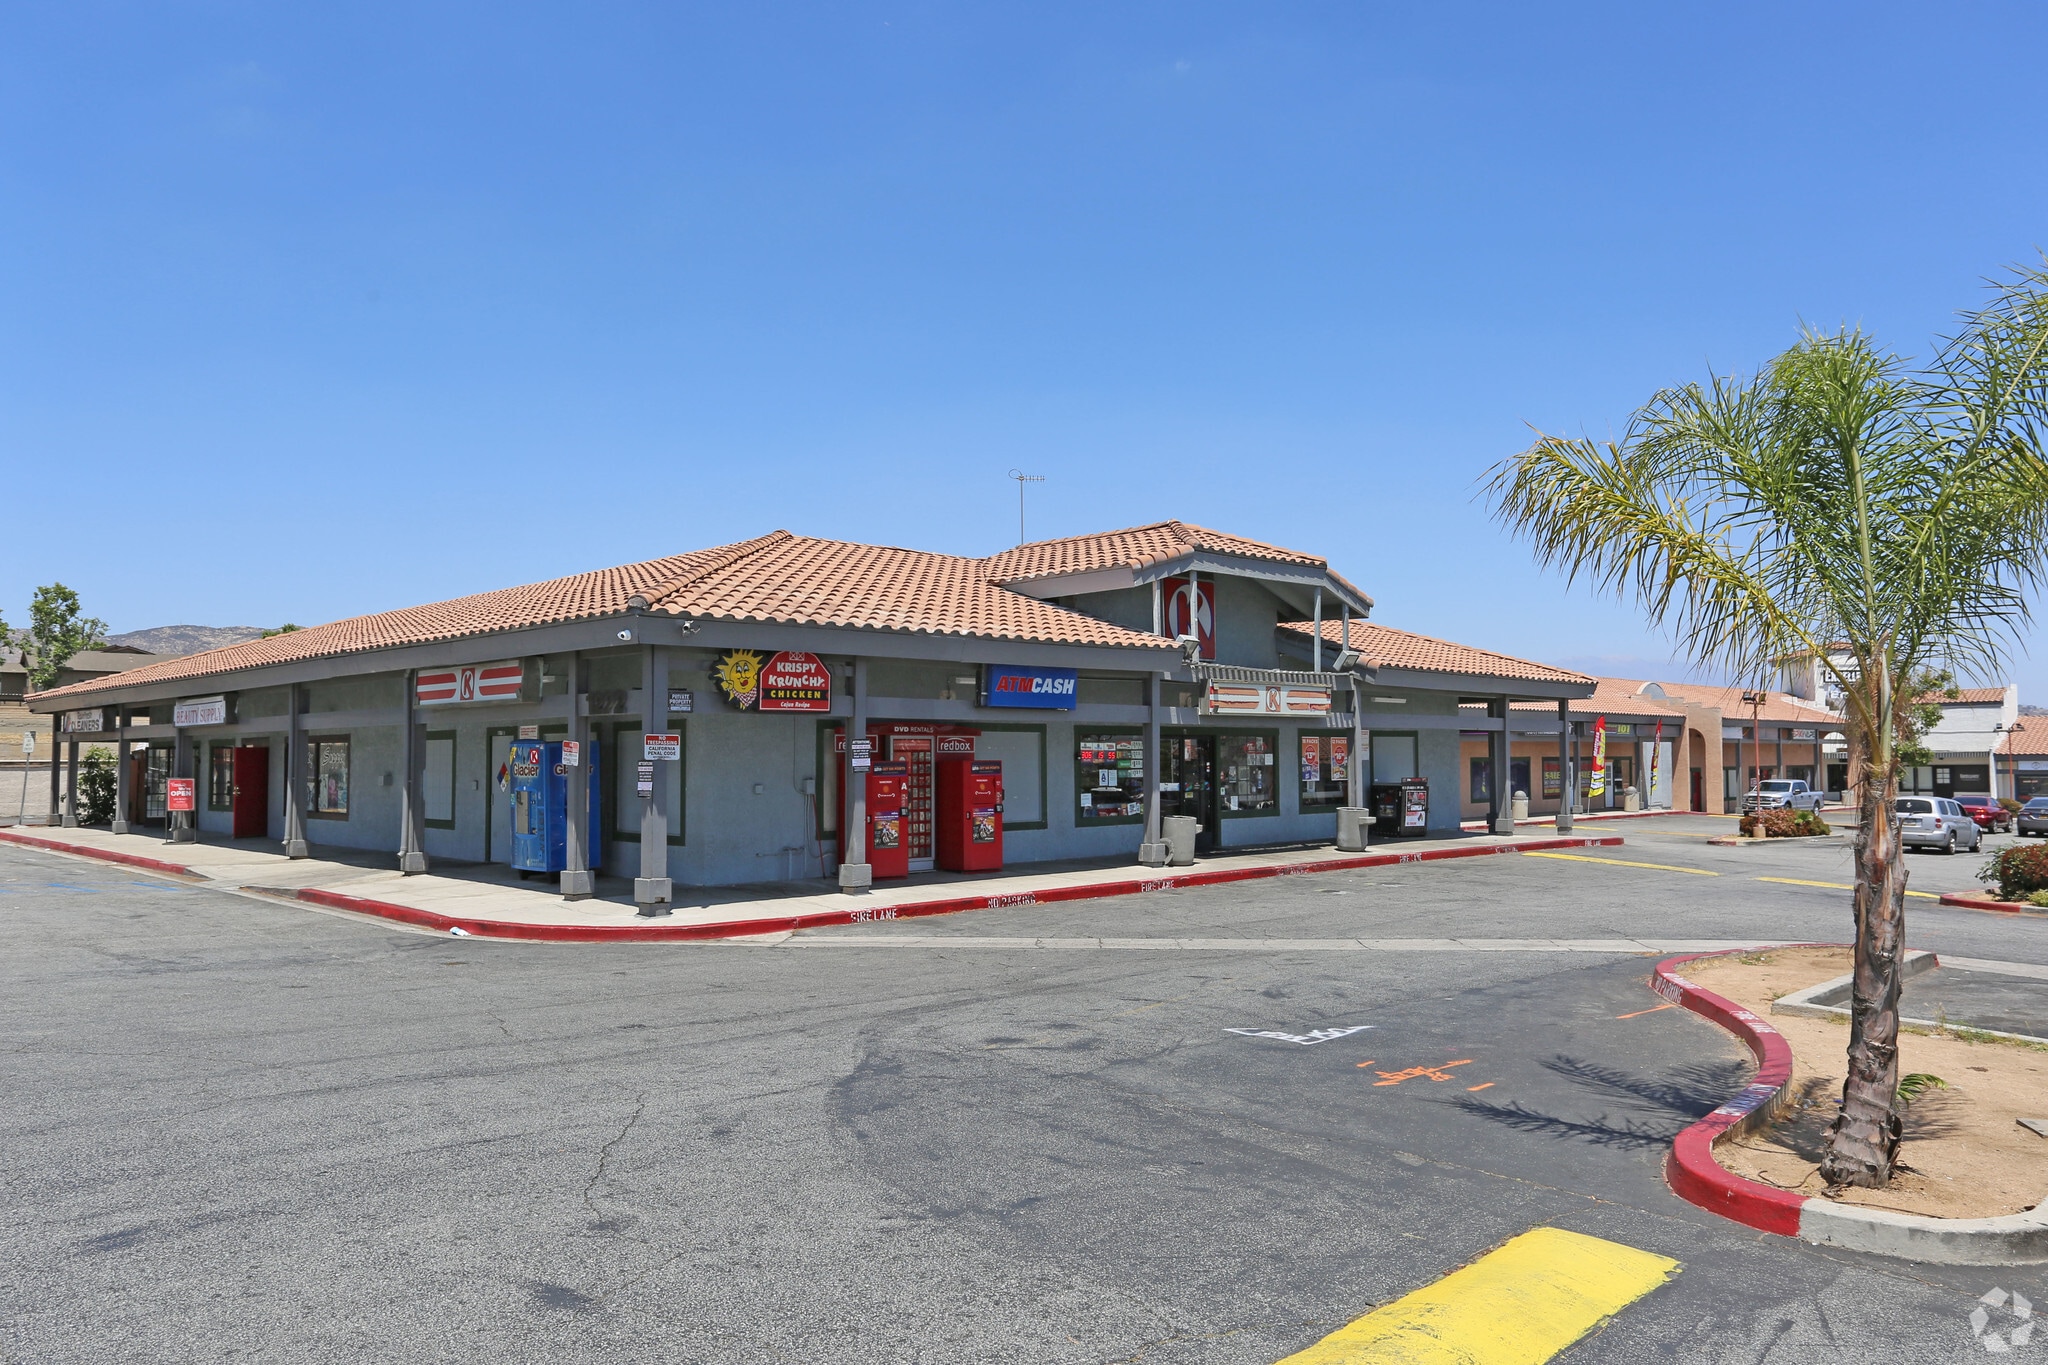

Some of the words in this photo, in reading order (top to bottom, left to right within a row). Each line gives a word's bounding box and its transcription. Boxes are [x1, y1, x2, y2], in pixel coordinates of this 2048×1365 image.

[777, 662, 817, 673] KRISPY
[768, 675, 825, 687] KRUNCHY
[770, 690, 821, 699] CHICKEN
[176, 707, 198, 724] BEAUTY
[200, 705, 223, 722] SUPPLY
[1617, 724, 1630, 733] 101
[940, 740, 971, 751] redbox
[513, 761, 539, 777] Glacier
[1544, 771, 1560, 779] SALE
[1580, 771, 1591, 779] ALE
[901, 782, 907, 790] A
[988, 897, 999, 908] NO
[1001, 894, 1036, 908] PARKING
[873, 908, 897, 921] LANE
[1660, 978, 1684, 1005] PARKING
